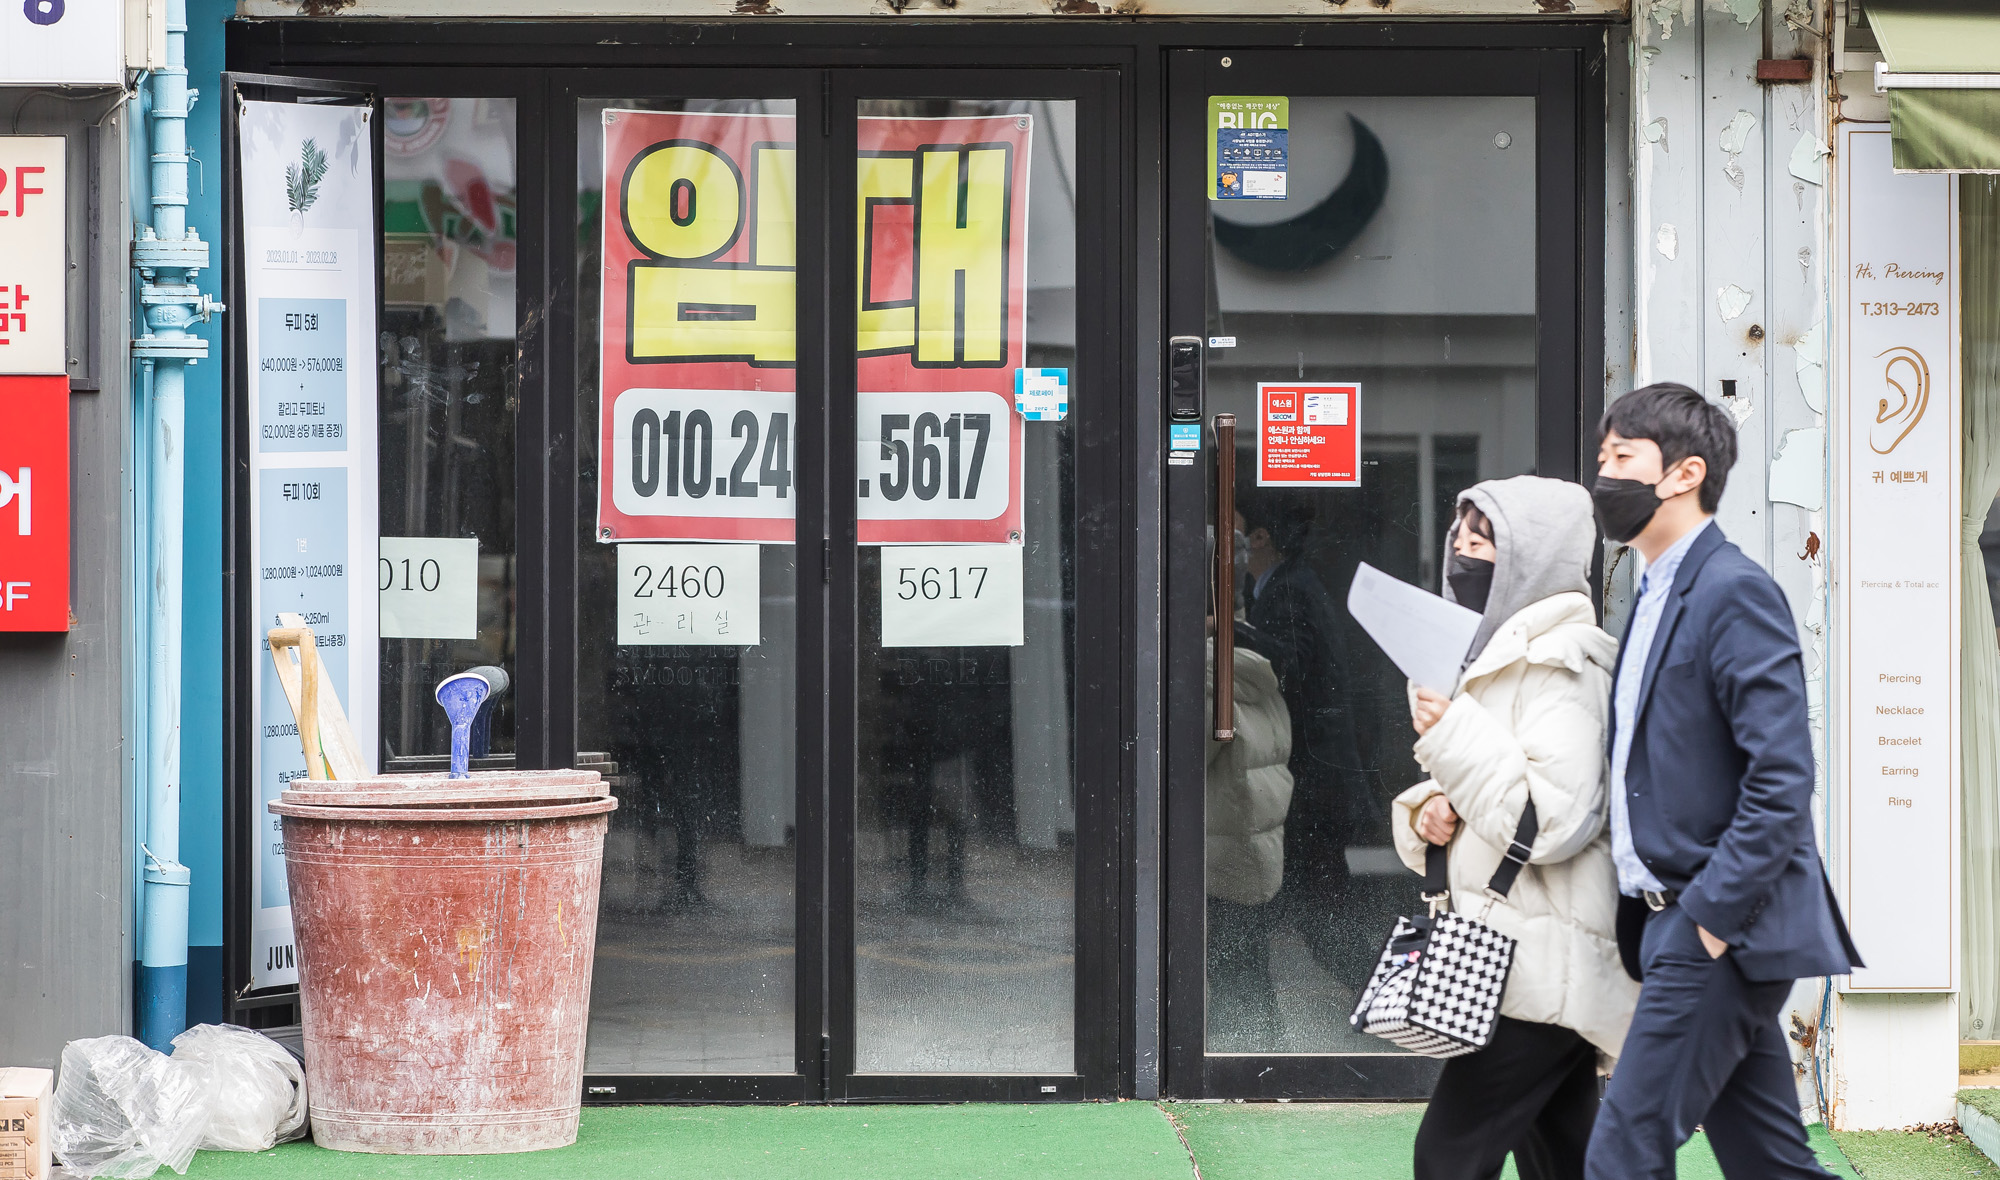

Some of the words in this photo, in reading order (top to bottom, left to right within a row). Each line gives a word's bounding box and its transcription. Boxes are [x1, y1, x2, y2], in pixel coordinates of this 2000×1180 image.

[1218, 112, 1278, 129] BUG
[266, 250, 298, 263] 2023.01.01
[306, 251, 337, 264] 2023.02.28
[1855, 263, 1877, 280] Hi,
[1884, 263, 1944, 285] Piercing
[1860, 302, 1939, 316] T.313-2473
[285, 313, 302, 331] 두피
[304, 313, 319, 331] 5회
[261, 357, 297, 372] 640,000원
[307, 357, 343, 372] 576,000원
[1029, 389, 1053, 397] 제로페이
[278, 402, 298, 416] 칼리고
[299, 402, 326, 416] 두피토너
[1272, 399, 1292, 408] 에스원
[262, 424, 296, 439] (52,000원
[297, 424, 310, 438] 상당
[311, 424, 325, 438] 제품
[326, 423, 343, 438] 증정)
[1267, 426, 1295, 434] 에스원과
[1296, 426, 1310, 434] 함께
[1267, 436, 1289, 444] 언제나
[1289, 436, 1326, 444] 안심하세요!
[1872, 471, 1884, 483] 귀
[1890, 470, 1928, 483] 예쁘게
[283, 483, 300, 501] 두피
[302, 482, 321, 500] 10회
[262, 566, 297, 580] 1,280,000원
[305, 564, 343, 578] 1,024,000원
[379, 557, 441, 591] 010
[633, 565, 725, 598] 2460
[897, 567, 988, 600] 5617
[1861, 580, 1893, 589] Piercing
[1904, 580, 1925, 588] Total
[0, 582, 31, 611] F
[1879, 673, 1922, 685] Piercing
[1876, 706, 1924, 715] Necklace
[1878, 736, 1922, 746] Bracelet
[1881, 766, 1919, 777] Earring
[1888, 797, 1912, 808] Ring
